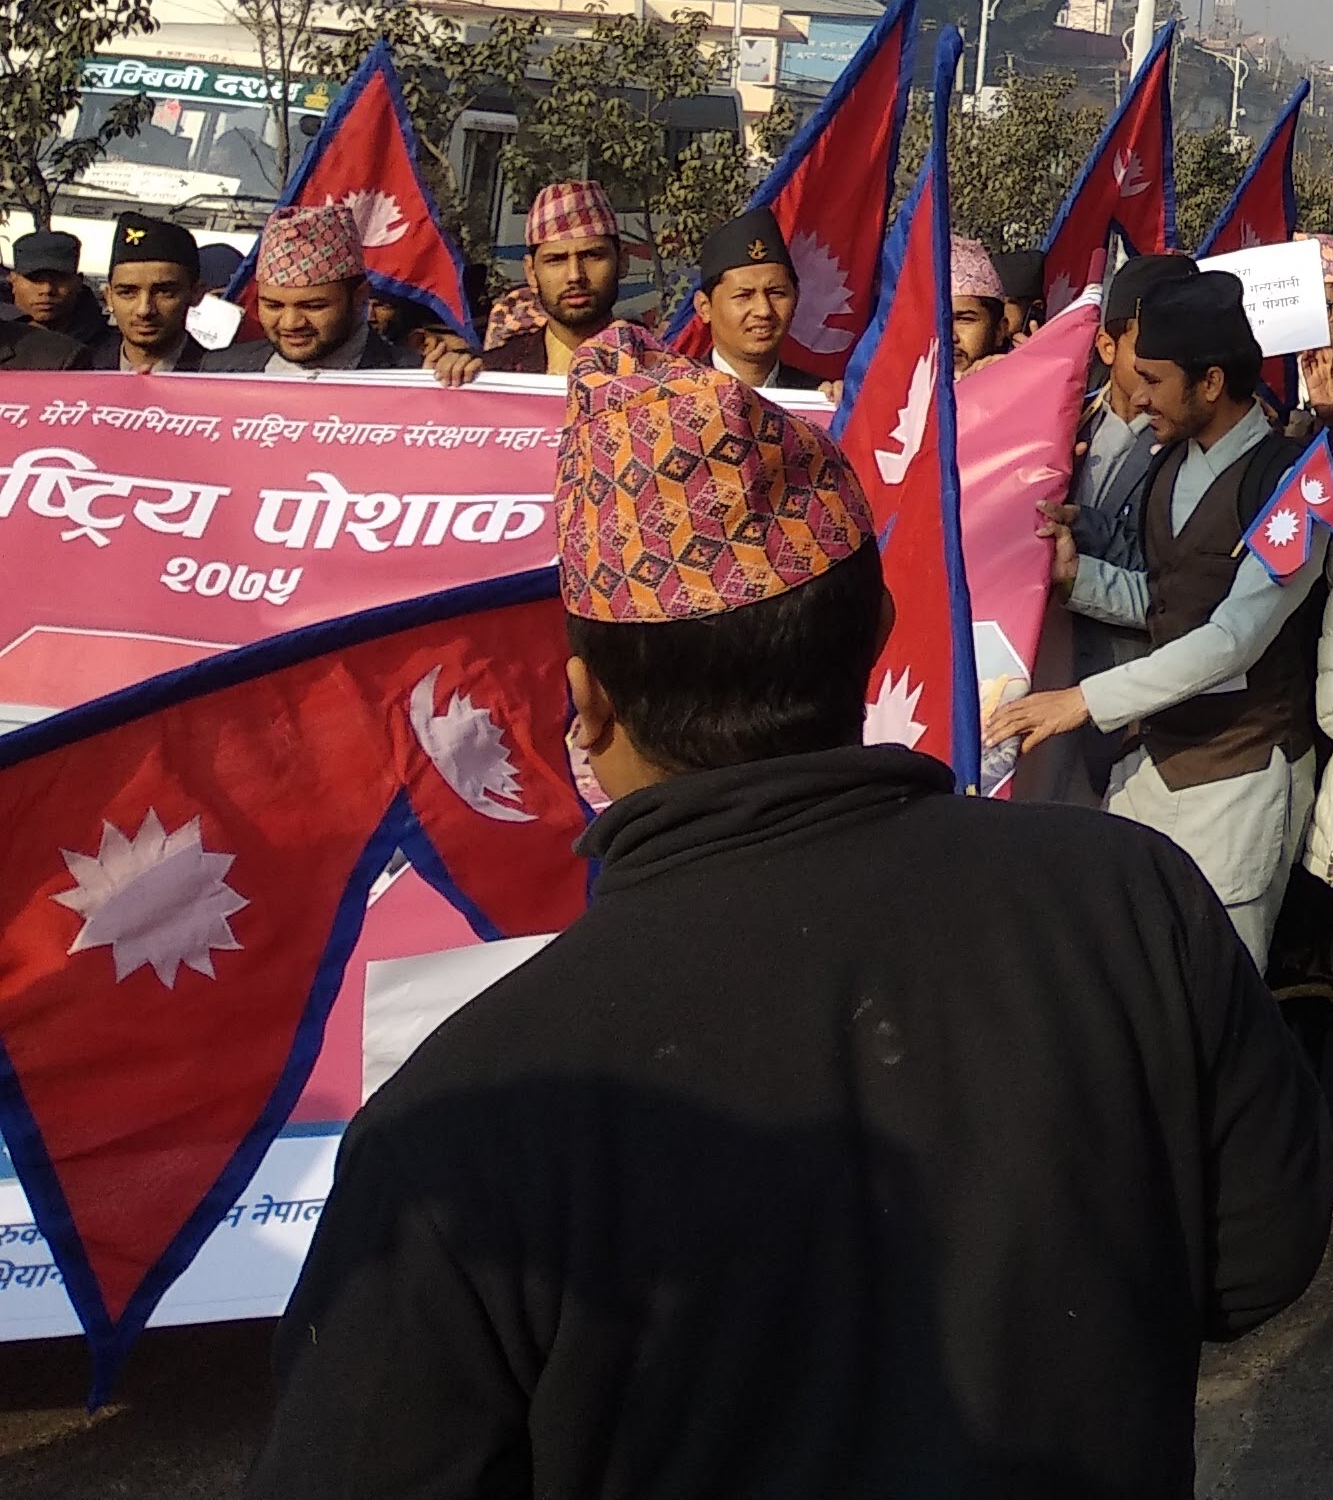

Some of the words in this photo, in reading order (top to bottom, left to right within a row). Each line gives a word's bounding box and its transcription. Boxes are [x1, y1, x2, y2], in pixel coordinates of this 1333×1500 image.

[83, 60, 208, 91] लुम्बिनी
[39, 400, 87, 427] मेरो
[232, 414, 305, 448] राष्ट्रिय
[312, 415, 399, 448] पोशाक
[403, 419, 494, 449] संरक्षण
[253, 471, 557, 553] पोशाक
[160, 557, 303, 606] २०७५
